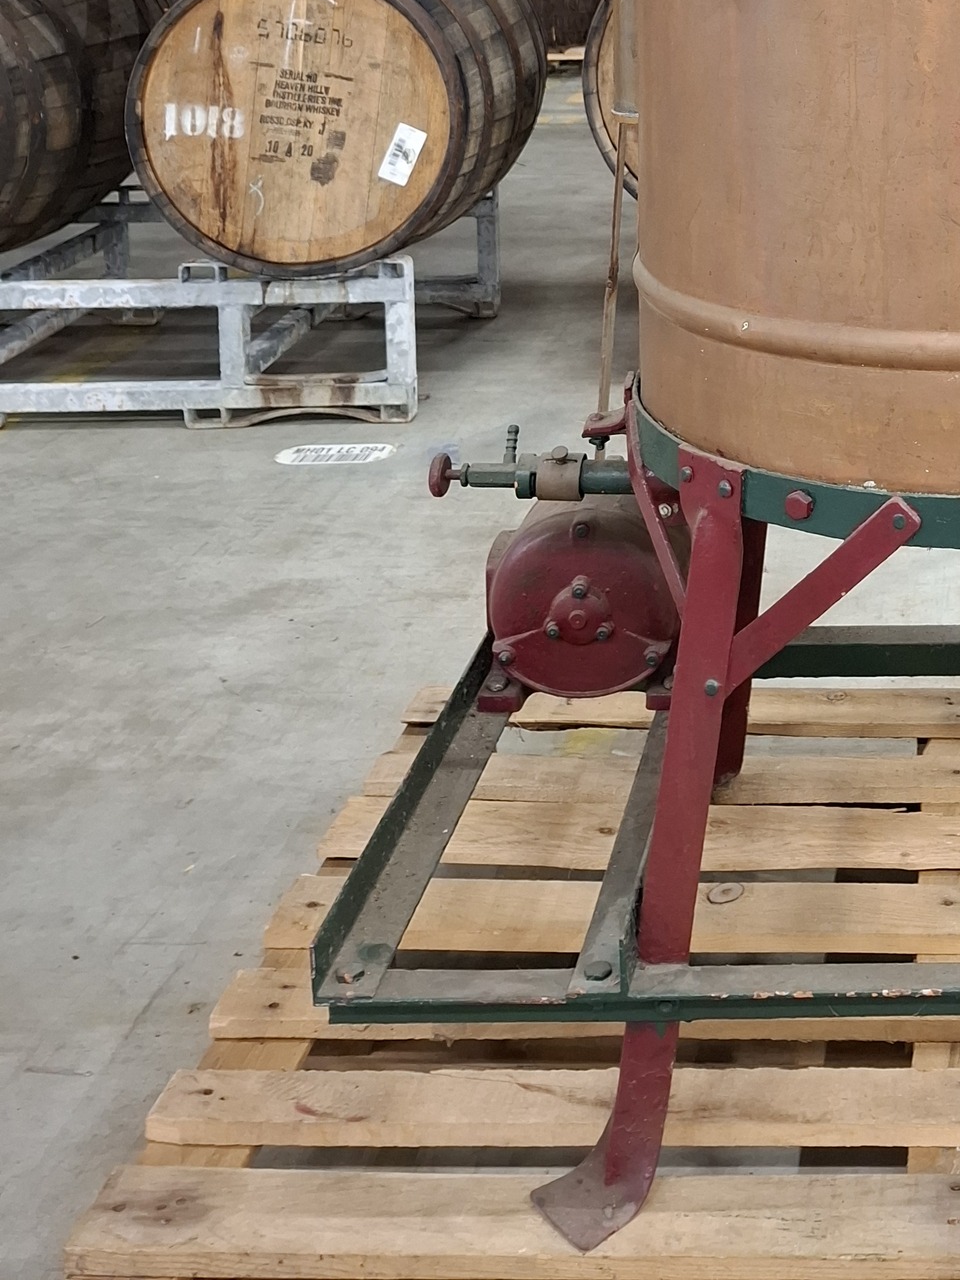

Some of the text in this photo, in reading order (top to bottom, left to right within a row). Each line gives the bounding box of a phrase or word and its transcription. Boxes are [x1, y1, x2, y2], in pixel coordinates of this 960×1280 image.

[279, 68, 304, 82] SERIAL
[274, 80, 305, 93] HEAVEN
[305, 104, 341, 118] WHISKEY
[300, 143, 314, 158] 20
